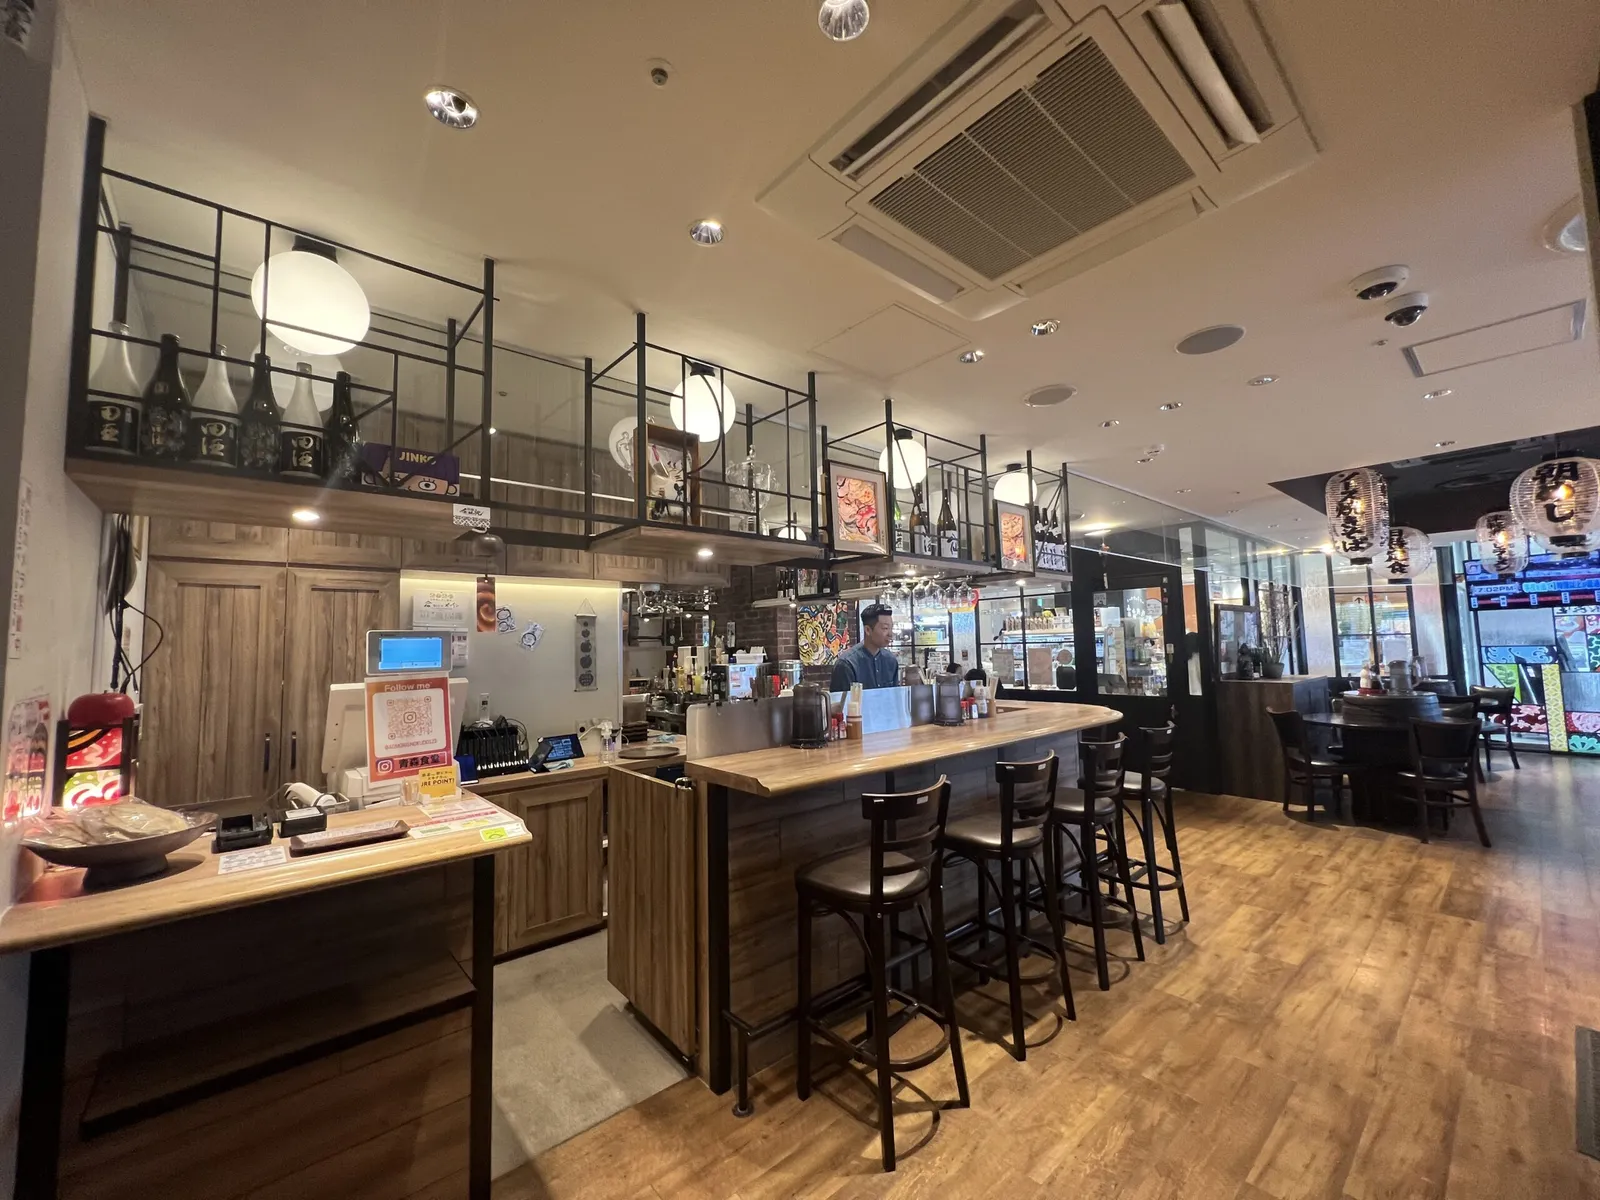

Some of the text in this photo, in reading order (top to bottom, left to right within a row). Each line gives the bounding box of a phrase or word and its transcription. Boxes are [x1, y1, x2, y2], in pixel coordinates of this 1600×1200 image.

[384, 682, 431, 693] Follow me
[400, 754, 440, 768] 青森食堂
[421, 779, 431, 788] JRE
